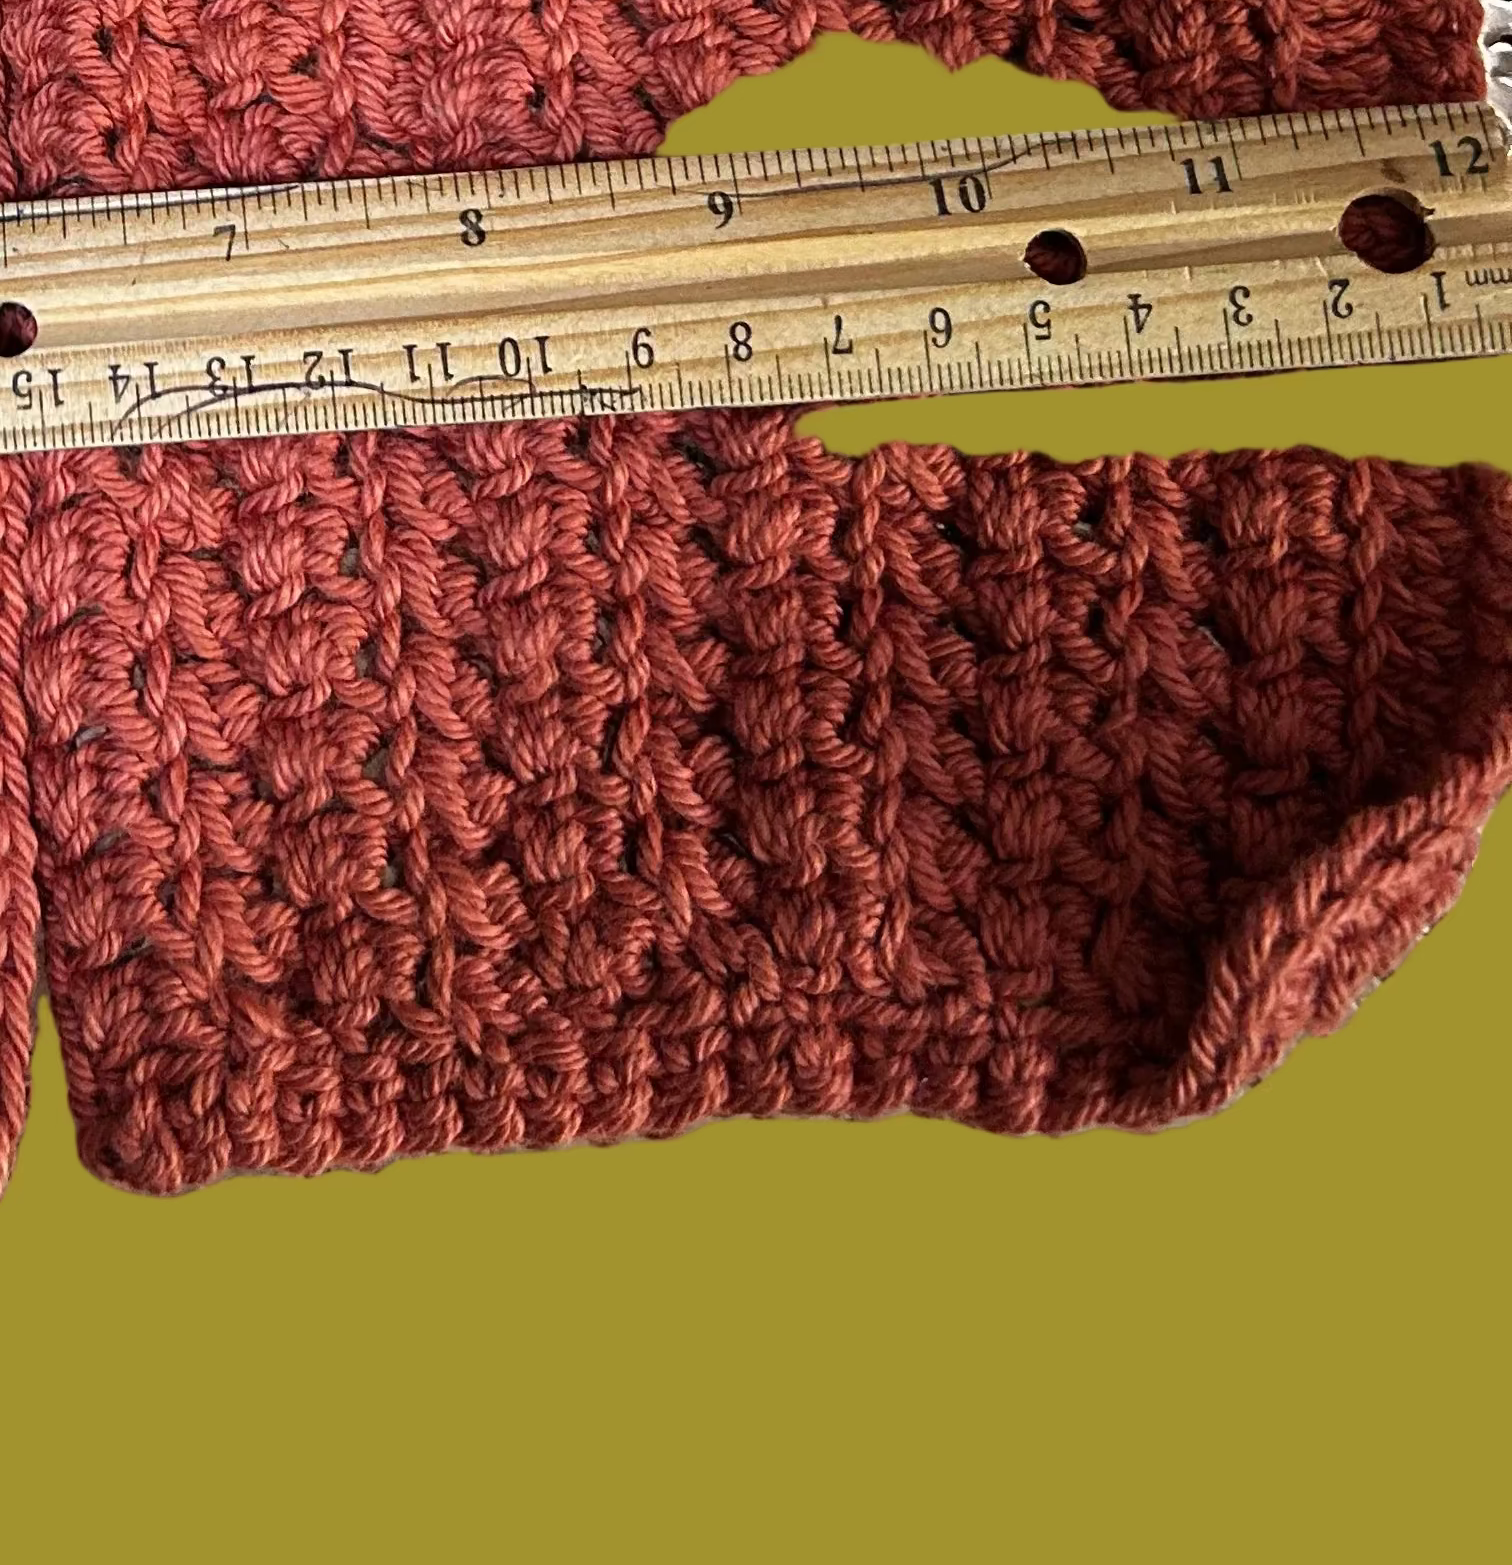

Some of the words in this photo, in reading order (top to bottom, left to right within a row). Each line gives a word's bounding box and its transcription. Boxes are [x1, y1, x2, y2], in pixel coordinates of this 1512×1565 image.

[213, 224, 237, 262] 7
[458, 208, 486, 246] 8
[707, 191, 734, 229] 9
[928, 175, 987, 216] 10
[1180, 156, 1233, 194] 11
[1429, 136, 1490, 176] 12
[1228, 285, 1253, 327] 3
[1327, 278, 1354, 319] 2
[1430, 271, 1451, 311] 1
[831, 314, 853, 355] 7
[928, 306, 953, 348] 6
[1028, 299, 1052, 341] 5
[1127, 293, 1153, 334] 4
[402, 341, 454, 383] 11
[498, 336, 553, 377] 10
[631, 327, 655, 369] 9
[728, 321, 753, 363] 8
[108, 361, 163, 404] 14
[205, 354, 256, 397] 13
[303, 347, 355, 388] 12
[11, 368, 65, 411] 15
